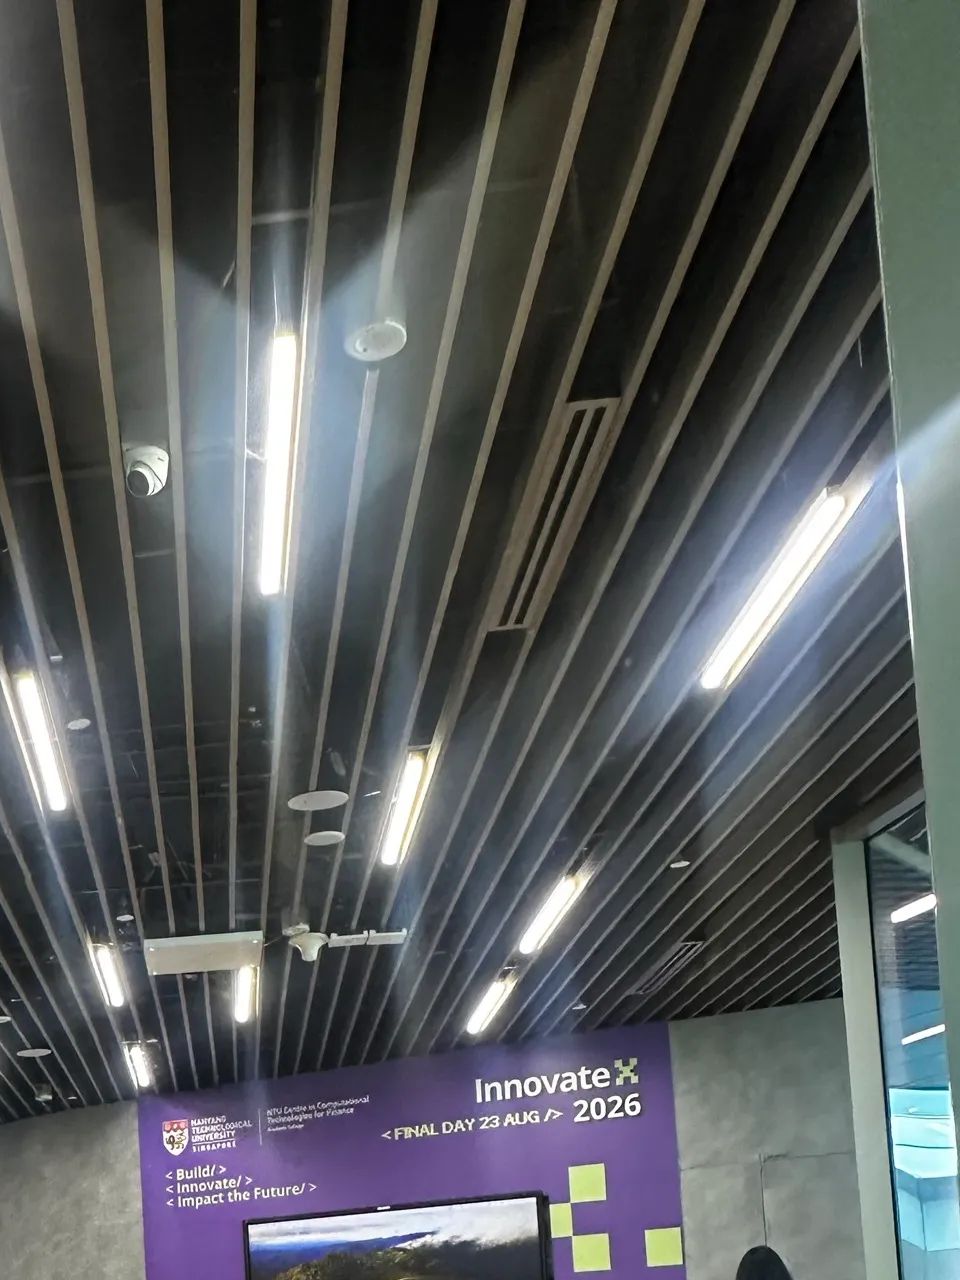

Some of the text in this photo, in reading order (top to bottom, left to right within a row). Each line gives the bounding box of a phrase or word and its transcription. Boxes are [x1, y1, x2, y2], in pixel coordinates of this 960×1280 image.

[573, 1093, 642, 1123] 2026
[442, 1118, 475, 1134] DAY
[479, 1115, 500, 1129] 23
[503, 1110, 540, 1127] AUG
[178, 1193, 226, 1209] Impact
[228, 1190, 250, 1203] the
